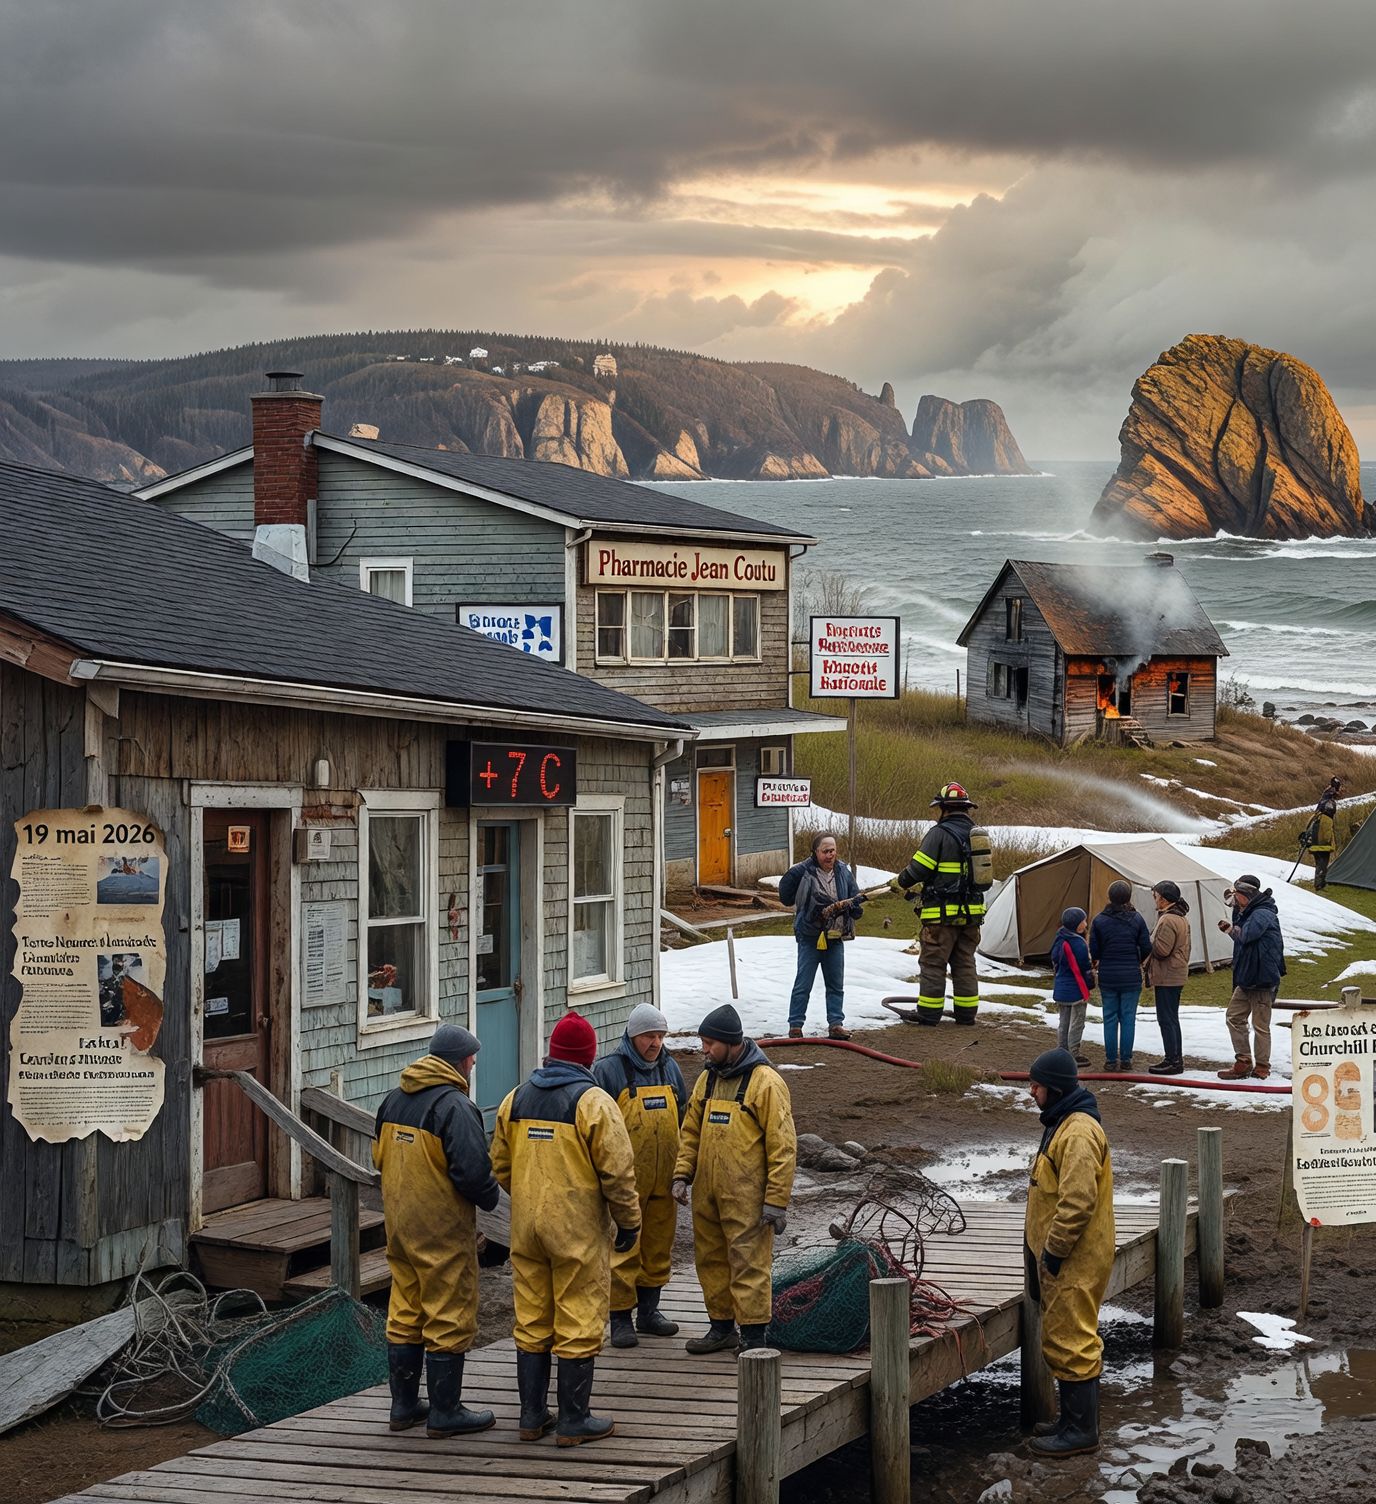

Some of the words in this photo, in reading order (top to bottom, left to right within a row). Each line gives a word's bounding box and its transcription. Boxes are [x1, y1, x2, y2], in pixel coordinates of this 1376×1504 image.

[599, 549, 688, 579] Pharmacie
[691, 552, 729, 582] Jean
[733, 555, 776, 581] Coutu
[540, 753, 561, 799] C
[23, 824, 49, 845] 19
[56, 824, 96, 844] mai
[102, 823, 155, 845] 2026
[1300, 1038, 1368, 1056] Churchill
